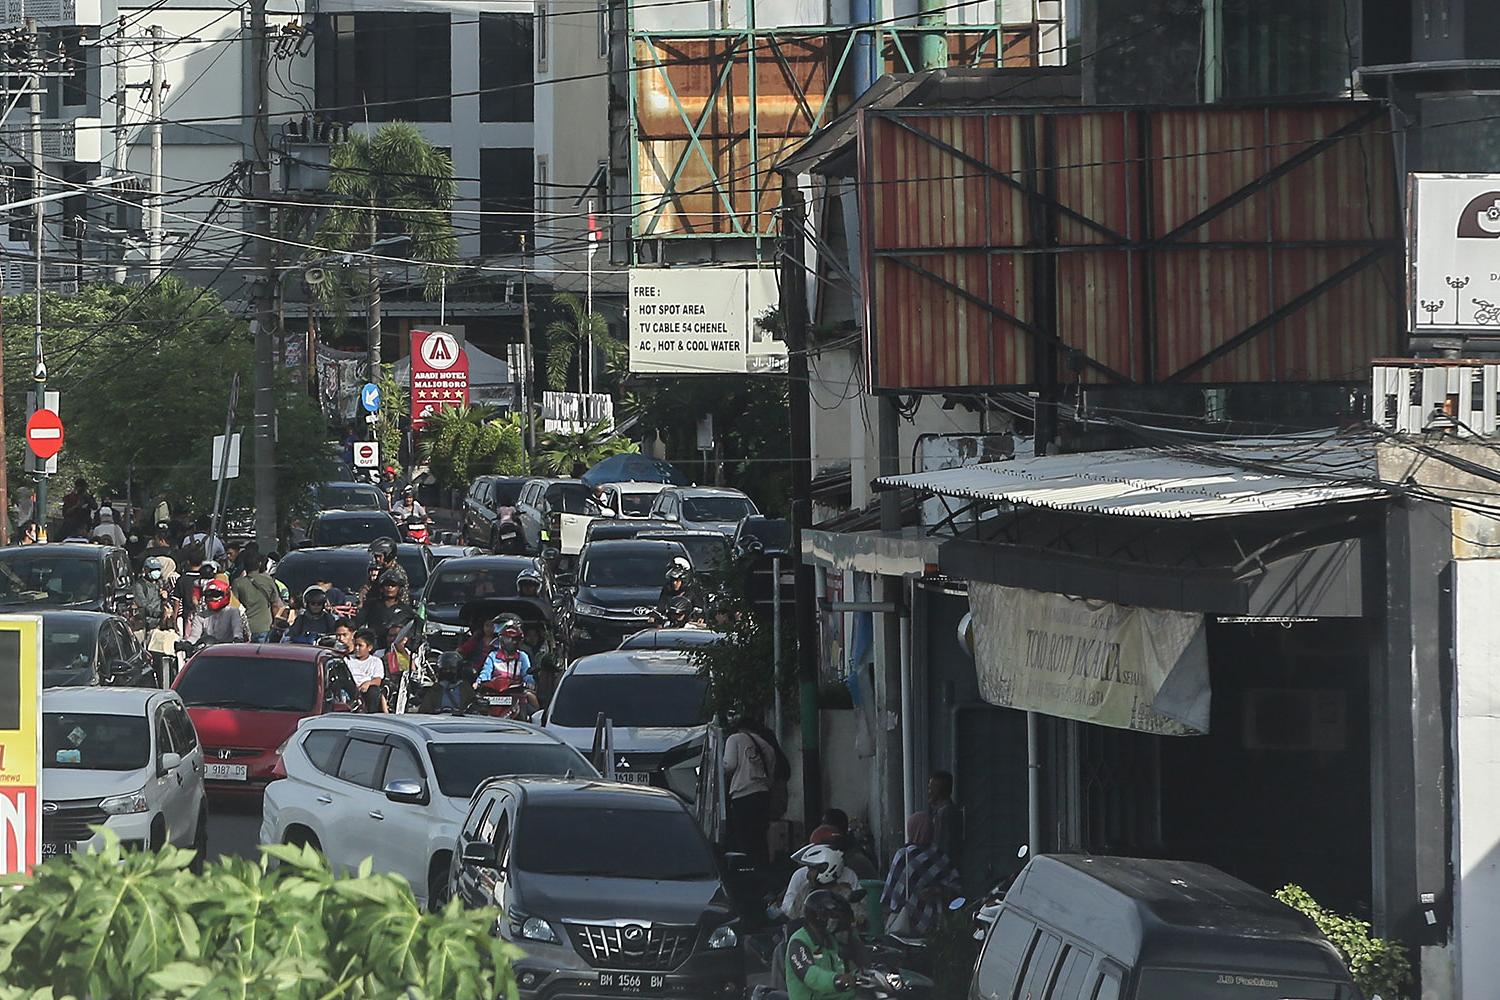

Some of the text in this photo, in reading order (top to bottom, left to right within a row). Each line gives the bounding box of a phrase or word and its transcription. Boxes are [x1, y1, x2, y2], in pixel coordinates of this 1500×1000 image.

[1490, 273, 1500, 281] D
[639, 305, 705, 315] HOT SPOT AREA
[639, 323, 728, 334] TV CABLE 54 CHENEL
[658, 341, 676, 351] HOT
[677, 341, 684, 351] &
[686, 341, 709, 351] COOL
[710, 341, 741, 351] WATER
[212, 765, 230, 774] 9187
[600, 974, 613, 986] BM
[618, 974, 641, 987] 1566
[1236, 976, 1278, 988] Fashion
